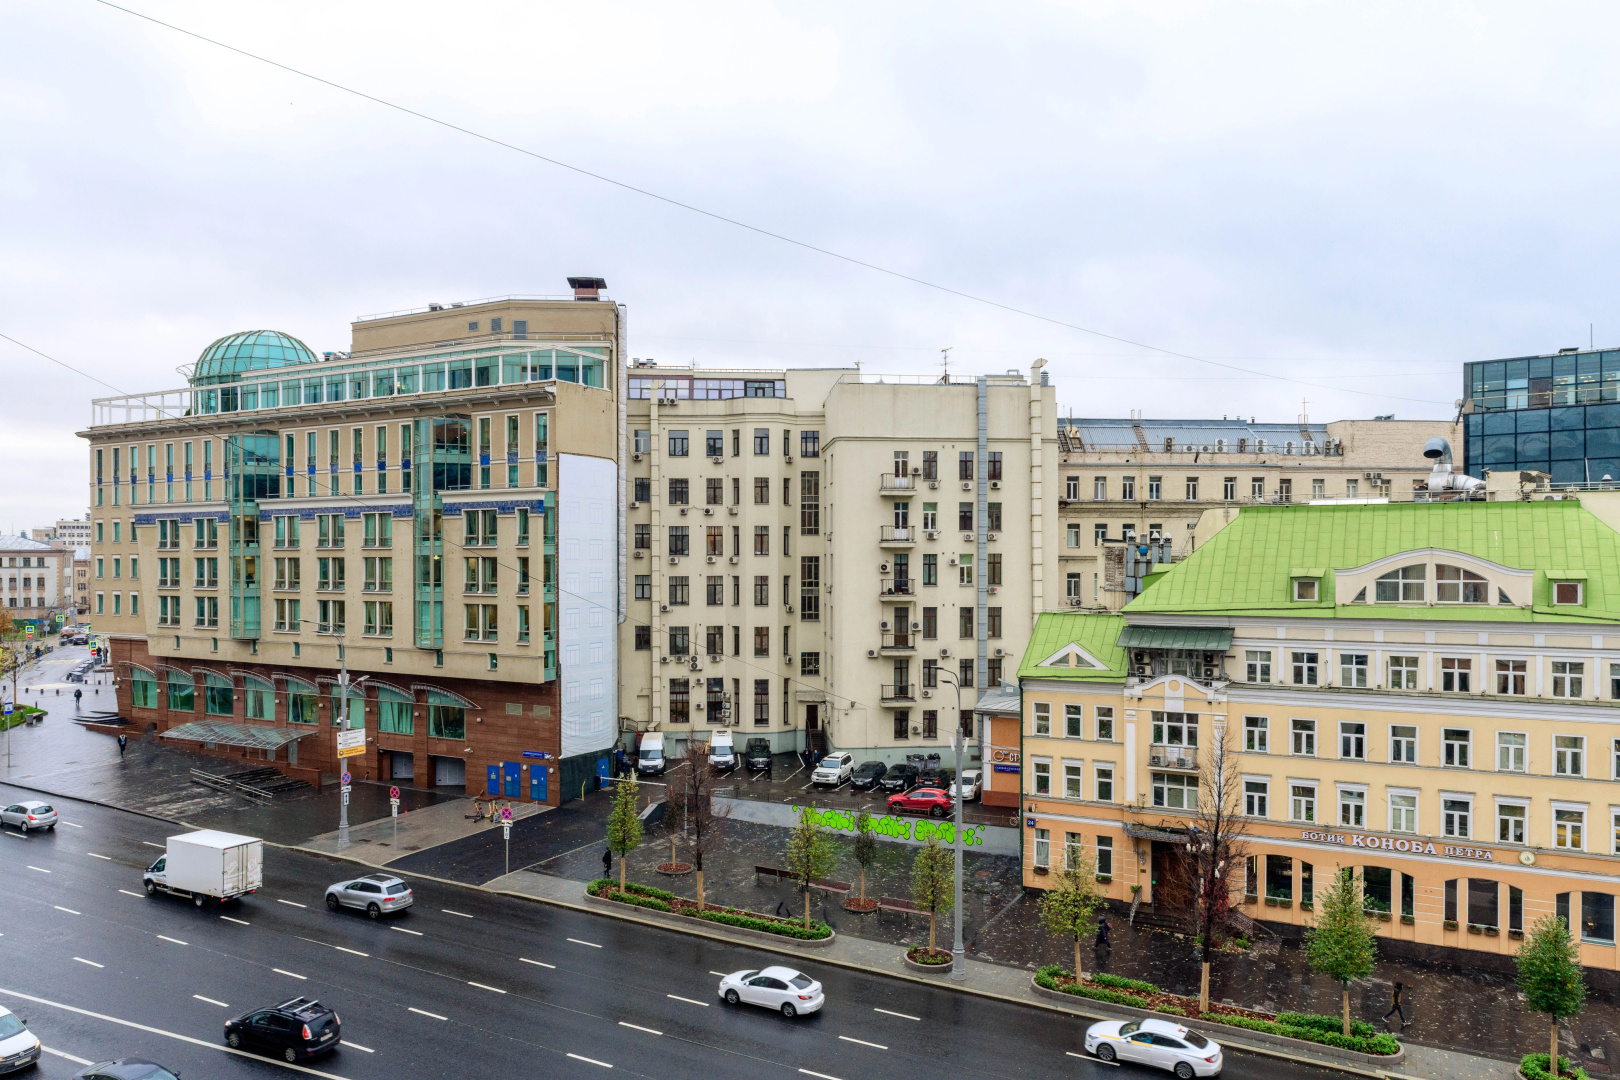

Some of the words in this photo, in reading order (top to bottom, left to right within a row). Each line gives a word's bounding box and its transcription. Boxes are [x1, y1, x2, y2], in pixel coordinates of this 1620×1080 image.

[1301, 830, 1345, 843] БОТИК
[1351, 834, 1438, 855] КОНОБА
[1444, 846, 1493, 861] ПЕТРА
